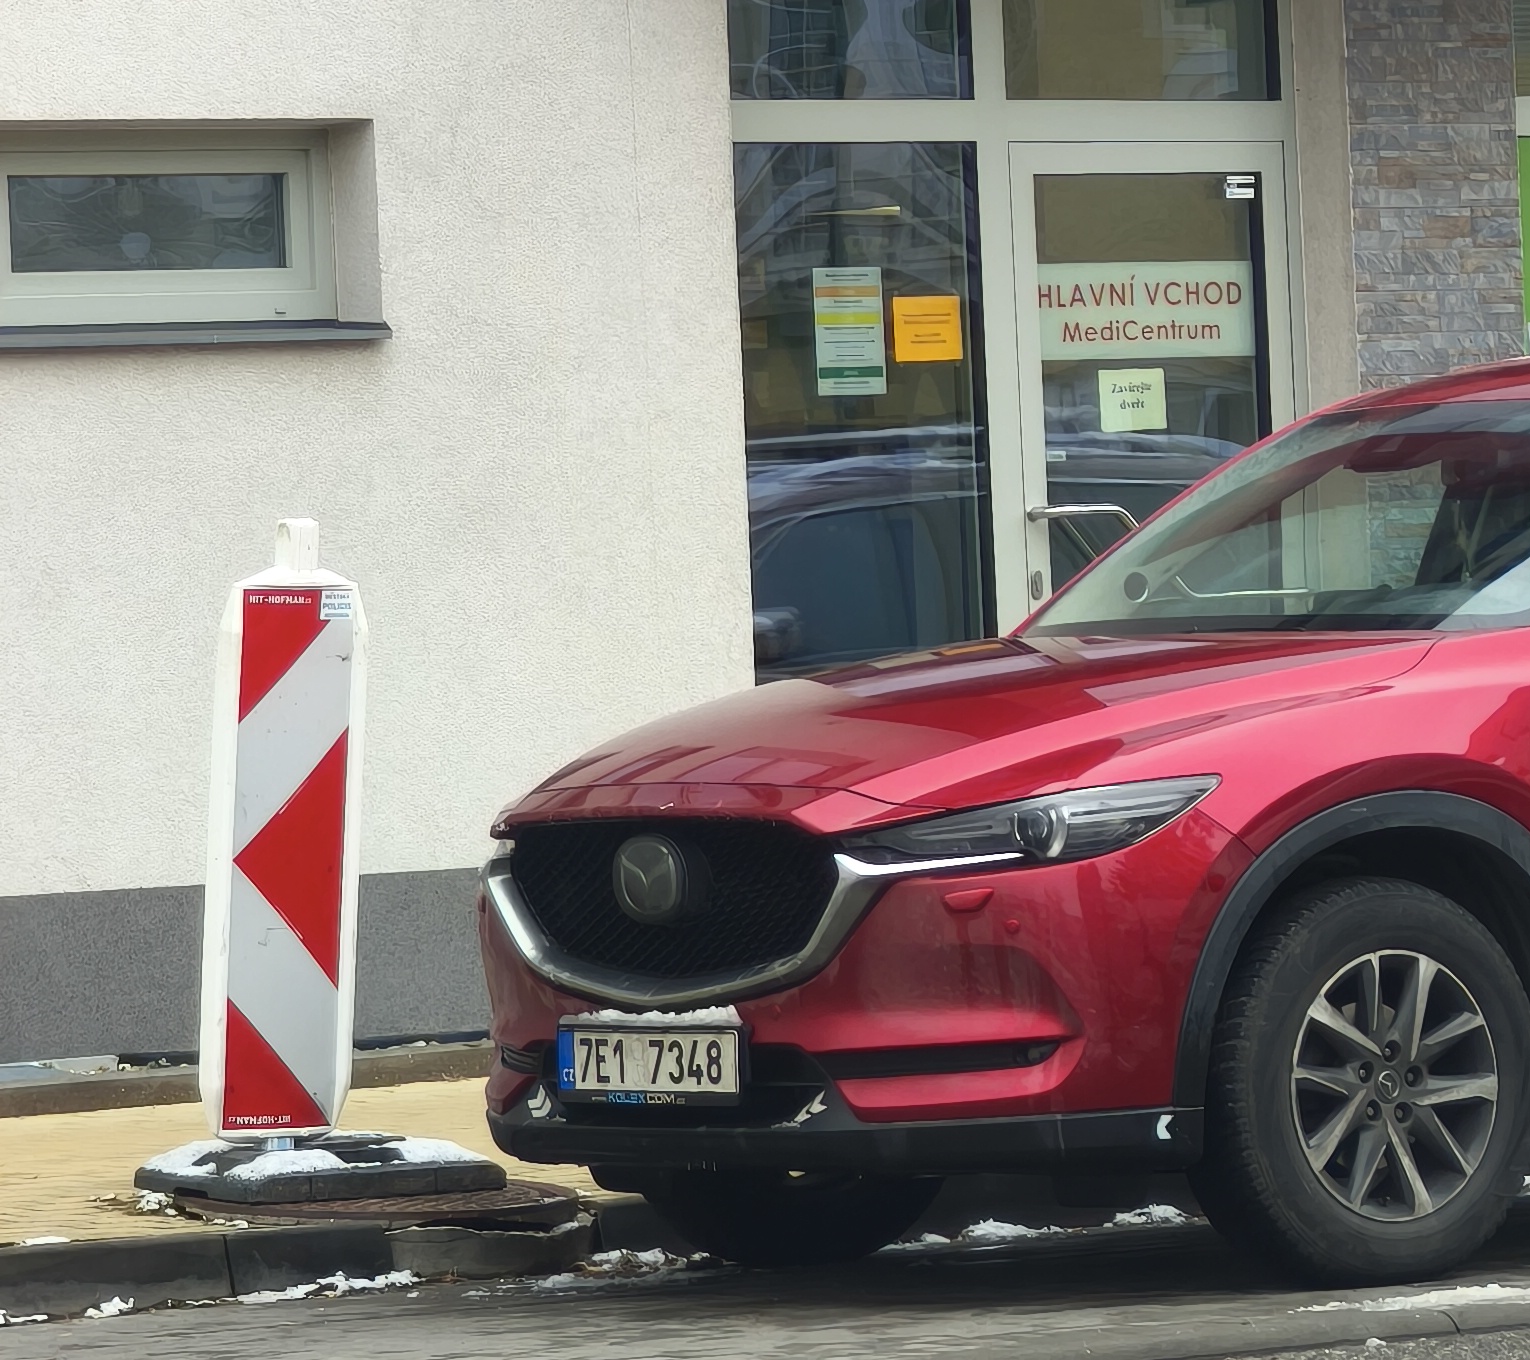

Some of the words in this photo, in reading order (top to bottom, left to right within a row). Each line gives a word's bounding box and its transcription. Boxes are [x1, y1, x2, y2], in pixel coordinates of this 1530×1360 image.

[1038, 274, 1136, 308] HLAVNÍ
[1144, 281, 1242, 307] VCHOD
[1062, 319, 1221, 343] MediCentrum
[562, 1068, 575, 1082] CZ
[579, 1036, 626, 1085] 7E1
[649, 1039, 723, 1086] 7348
